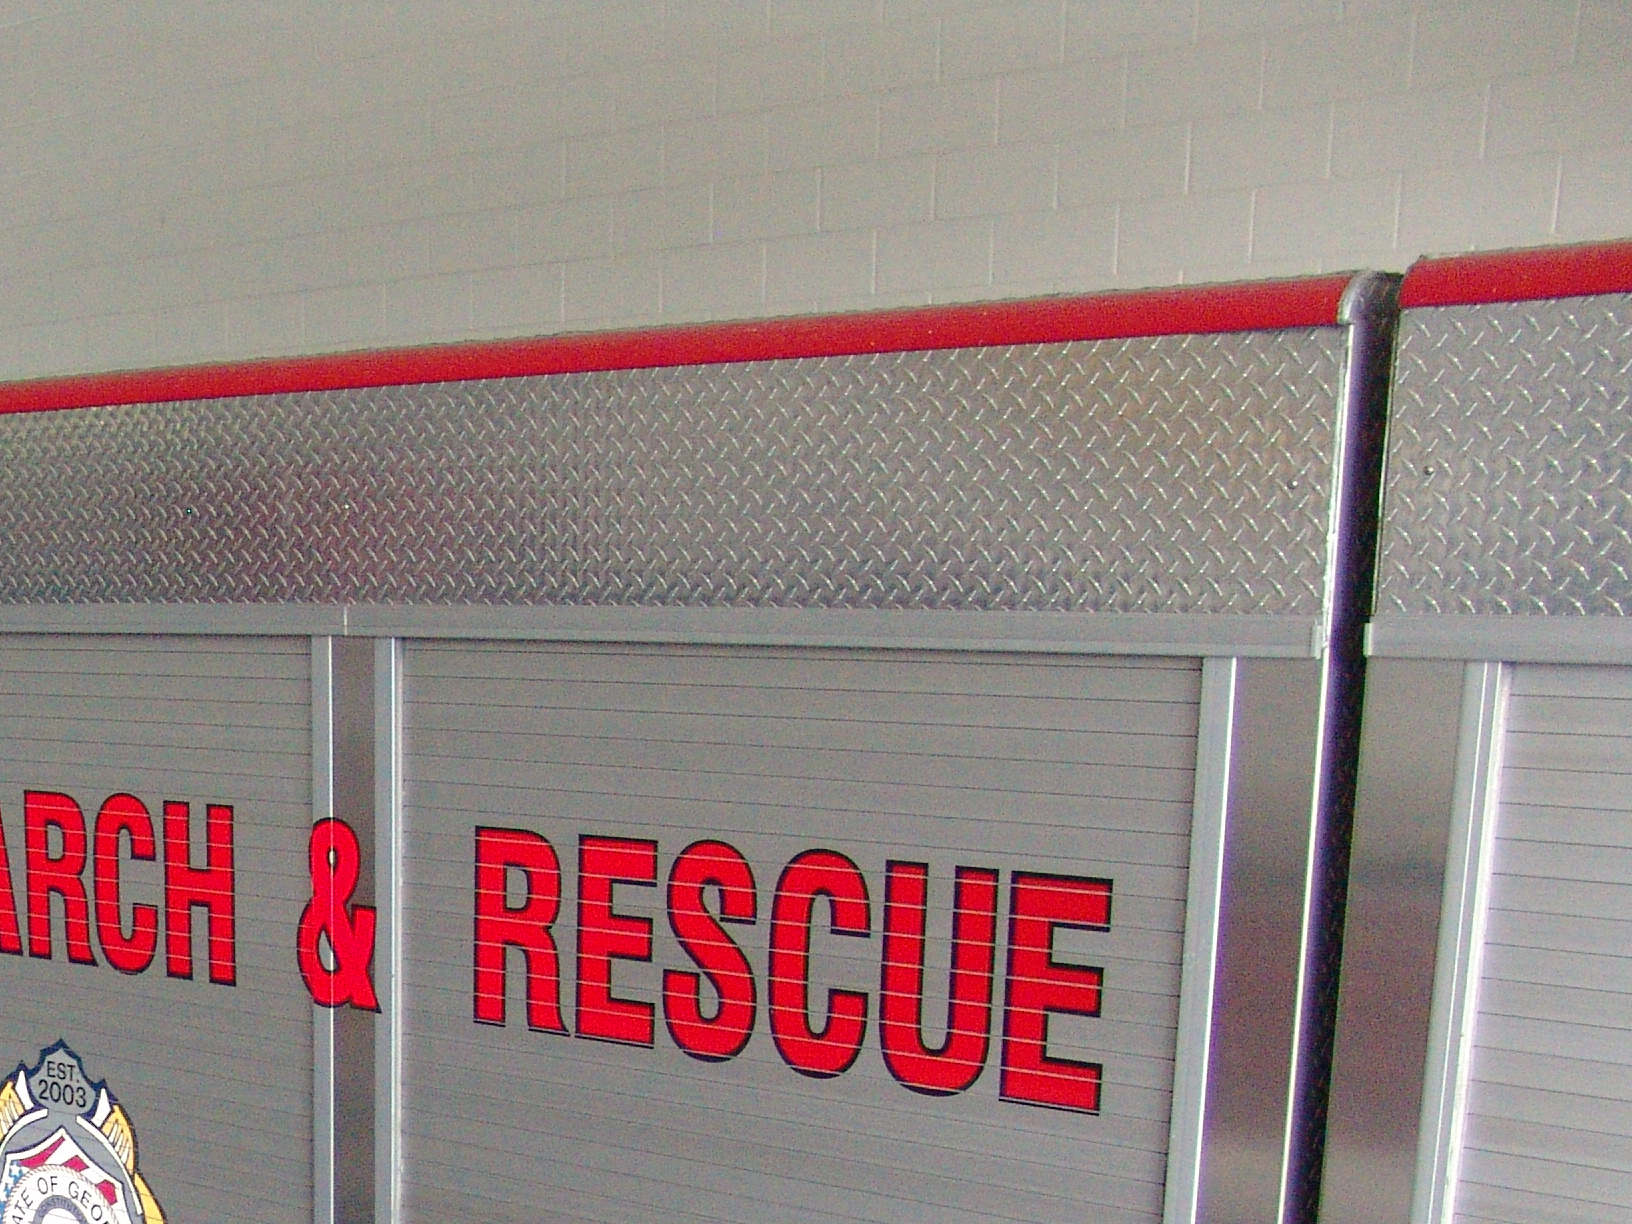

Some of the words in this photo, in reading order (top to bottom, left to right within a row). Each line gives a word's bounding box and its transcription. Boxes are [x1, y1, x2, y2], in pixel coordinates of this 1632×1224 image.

[296, 817, 382, 1013] &
[473, 825, 1114, 1116] RESCUE
[47, 1061, 79, 1083] EST.
[38, 1079, 86, 1108] 2003
[37, 1176, 58, 1195] OF
